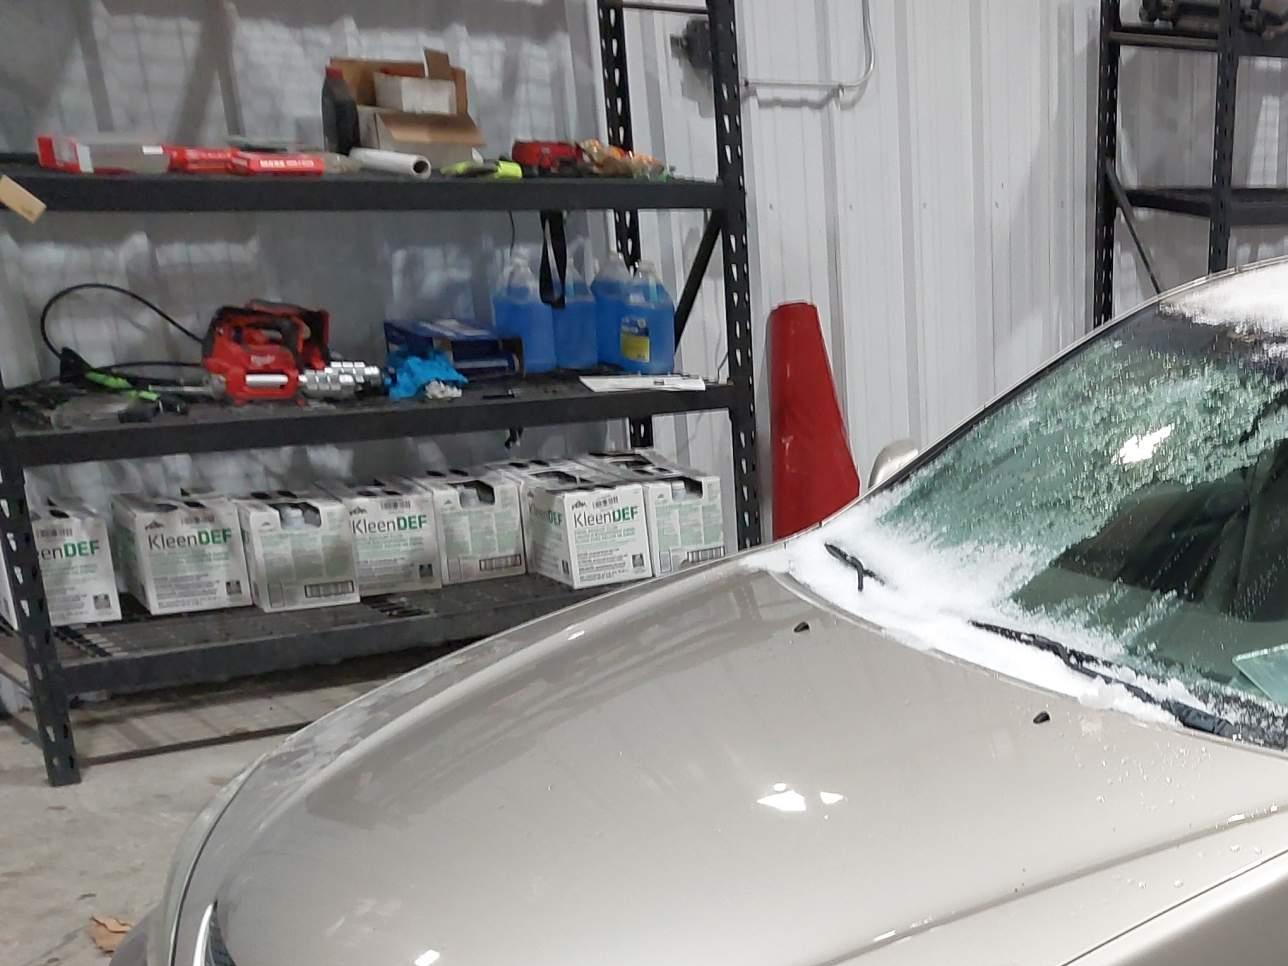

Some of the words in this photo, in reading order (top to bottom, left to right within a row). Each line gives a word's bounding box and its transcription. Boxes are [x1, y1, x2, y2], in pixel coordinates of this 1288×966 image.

[352, 514, 427, 534] KleenDEF
[573, 505, 639, 528] KleenDEF
[147, 528, 232, 550] KleenDEF
[40, 540, 100, 560] enDEF
